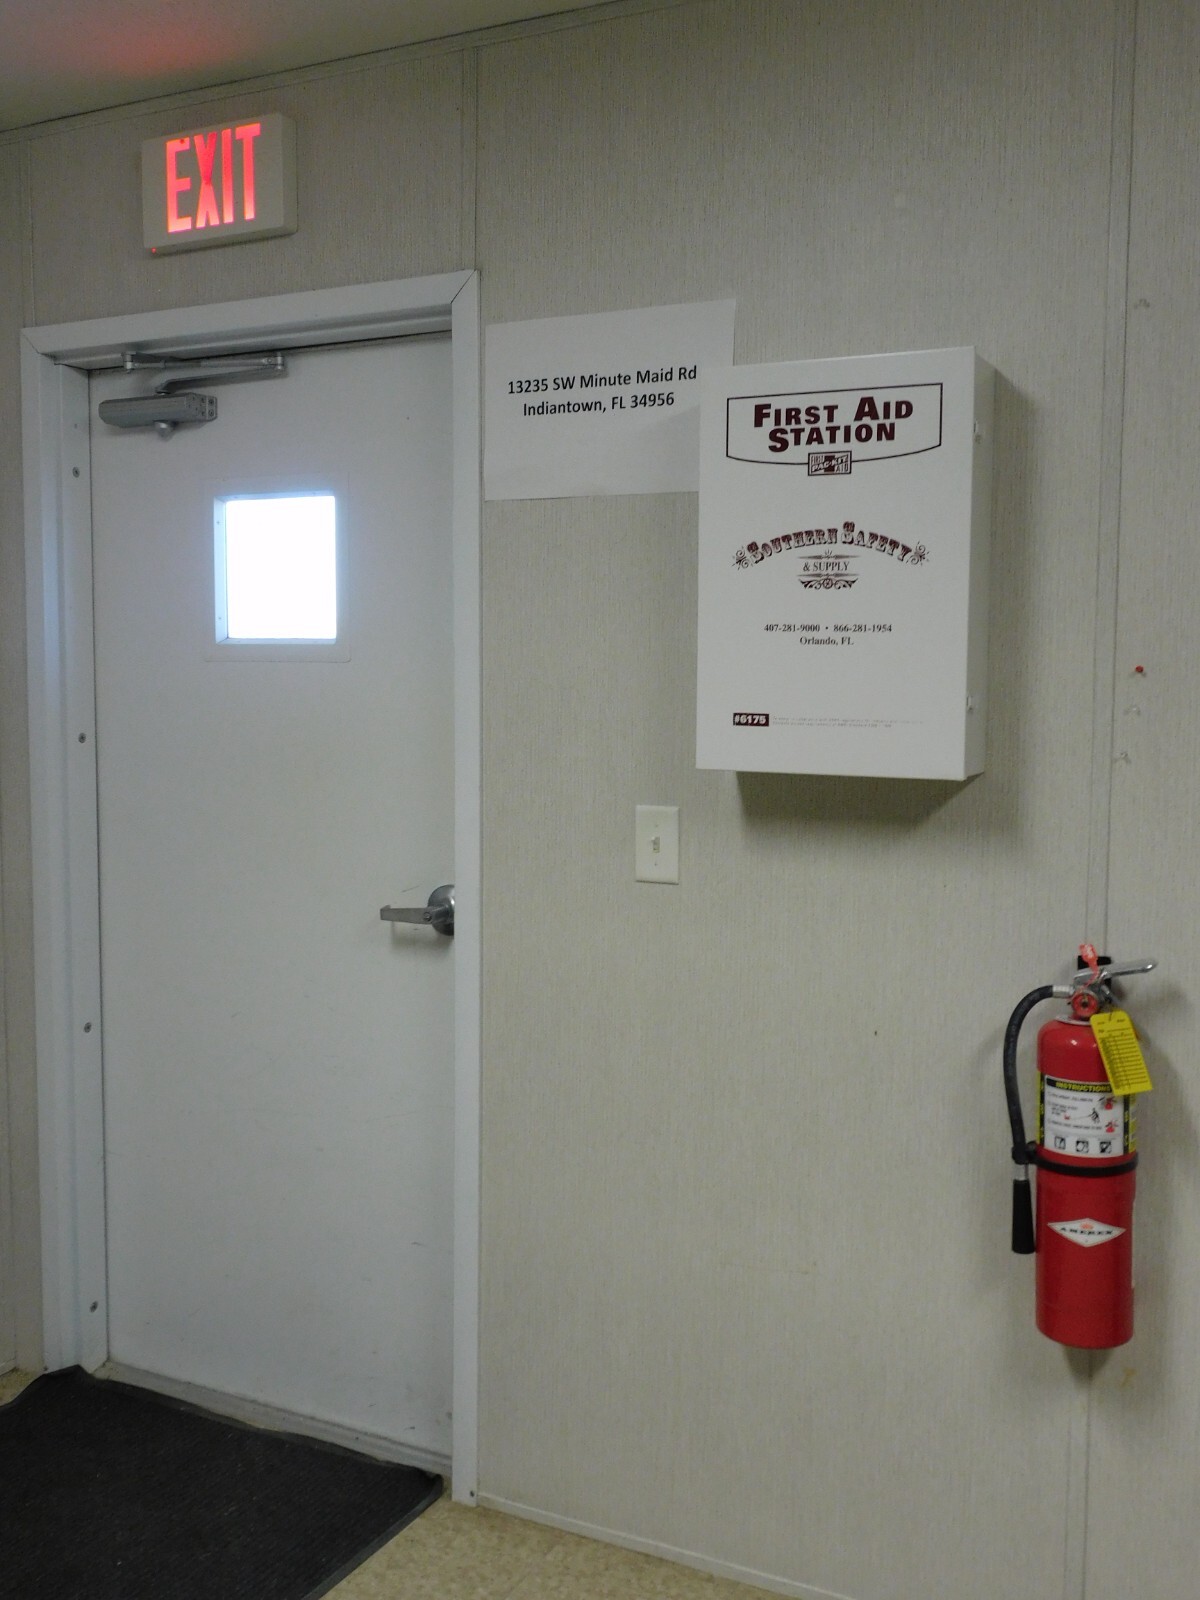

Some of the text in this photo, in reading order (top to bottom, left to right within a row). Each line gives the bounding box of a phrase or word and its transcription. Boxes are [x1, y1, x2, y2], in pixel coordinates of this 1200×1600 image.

[166, 122, 261, 233] EXIT
[508, 365, 697, 394] 13235 SW Minute Maid Rd
[523, 392, 675, 417] Indiantown, FL 34956
[753, 396, 913, 428] FIRST AID
[768, 422, 896, 453] STATION
[747, 521, 913, 564] SOUTHERN SAFETY
[803, 561, 850, 572] & SUPPLY
[764, 623, 893, 633] 407-281-9000 866-281-1954
[800, 636, 839, 647] Orlando,
[734, 714, 767, 726] #6175
